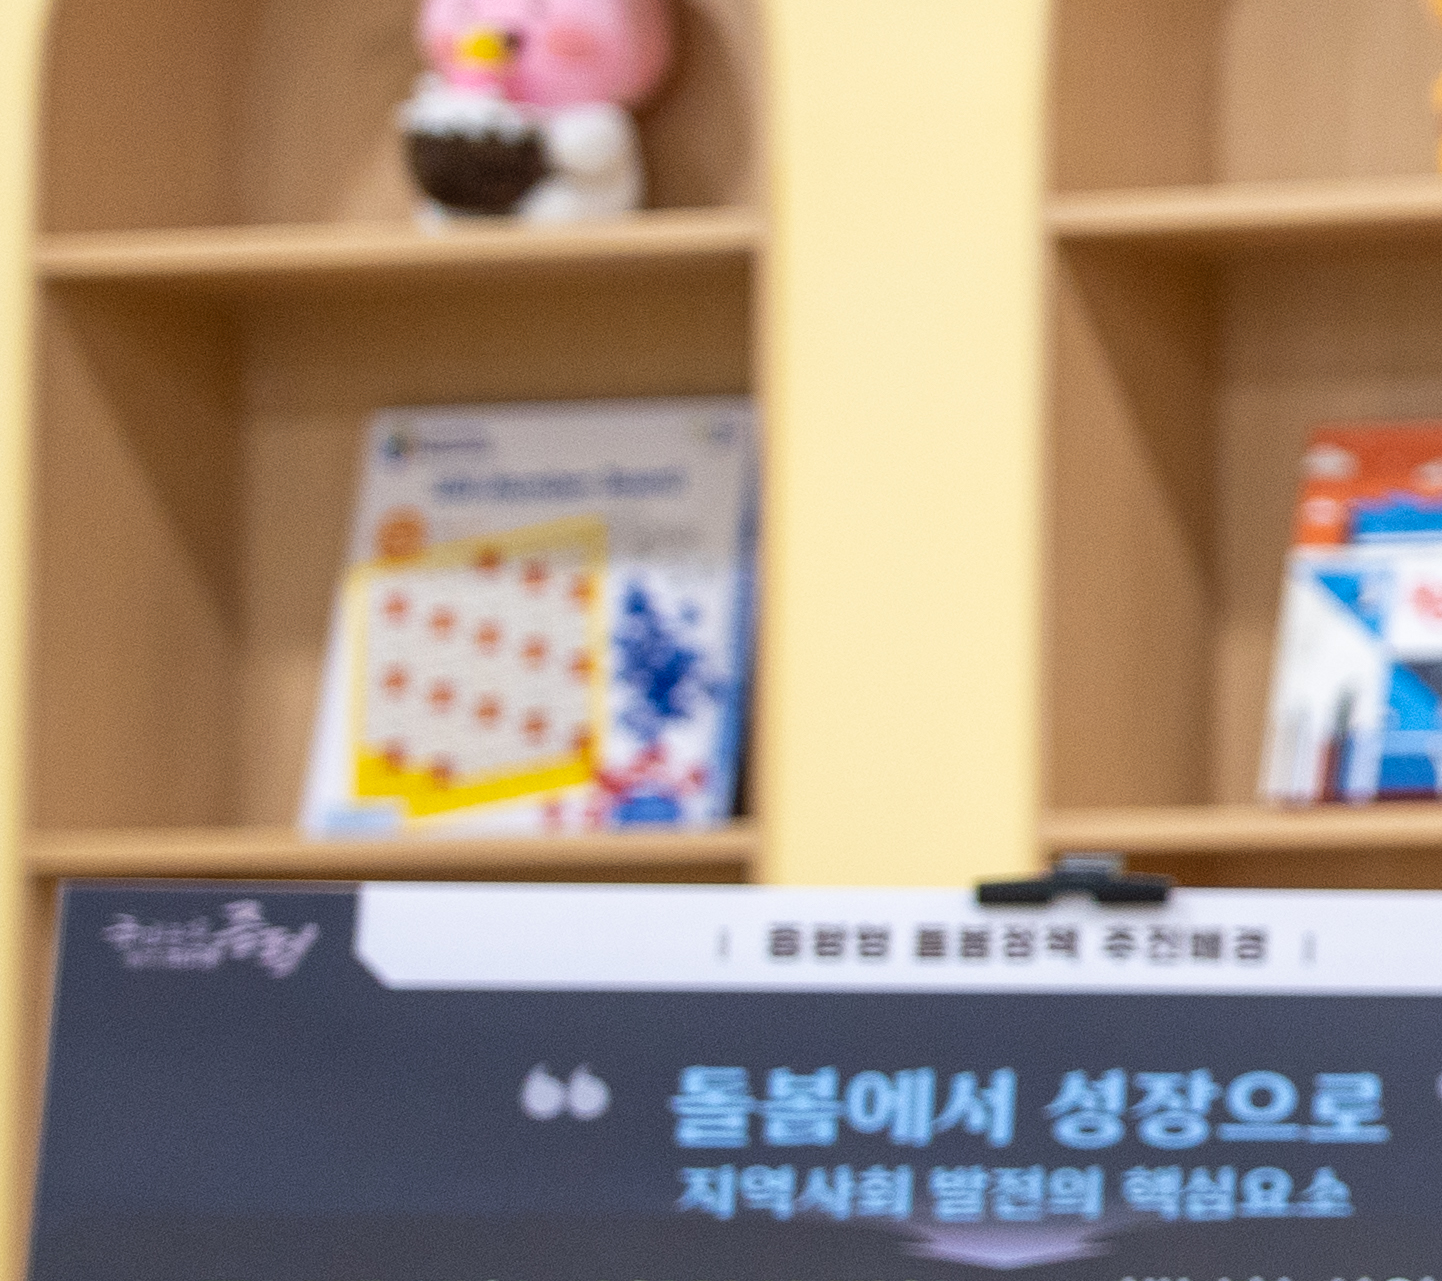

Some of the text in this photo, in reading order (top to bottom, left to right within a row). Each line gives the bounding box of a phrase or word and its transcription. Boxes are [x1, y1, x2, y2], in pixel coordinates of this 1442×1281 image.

[915, 924, 1080, 964] 돌봄정책
[672, 1066, 1391, 1150] 돌봄에서 성장으로
[675, 1164, 1355, 1220] 지역사회 발전의 핵심요소
